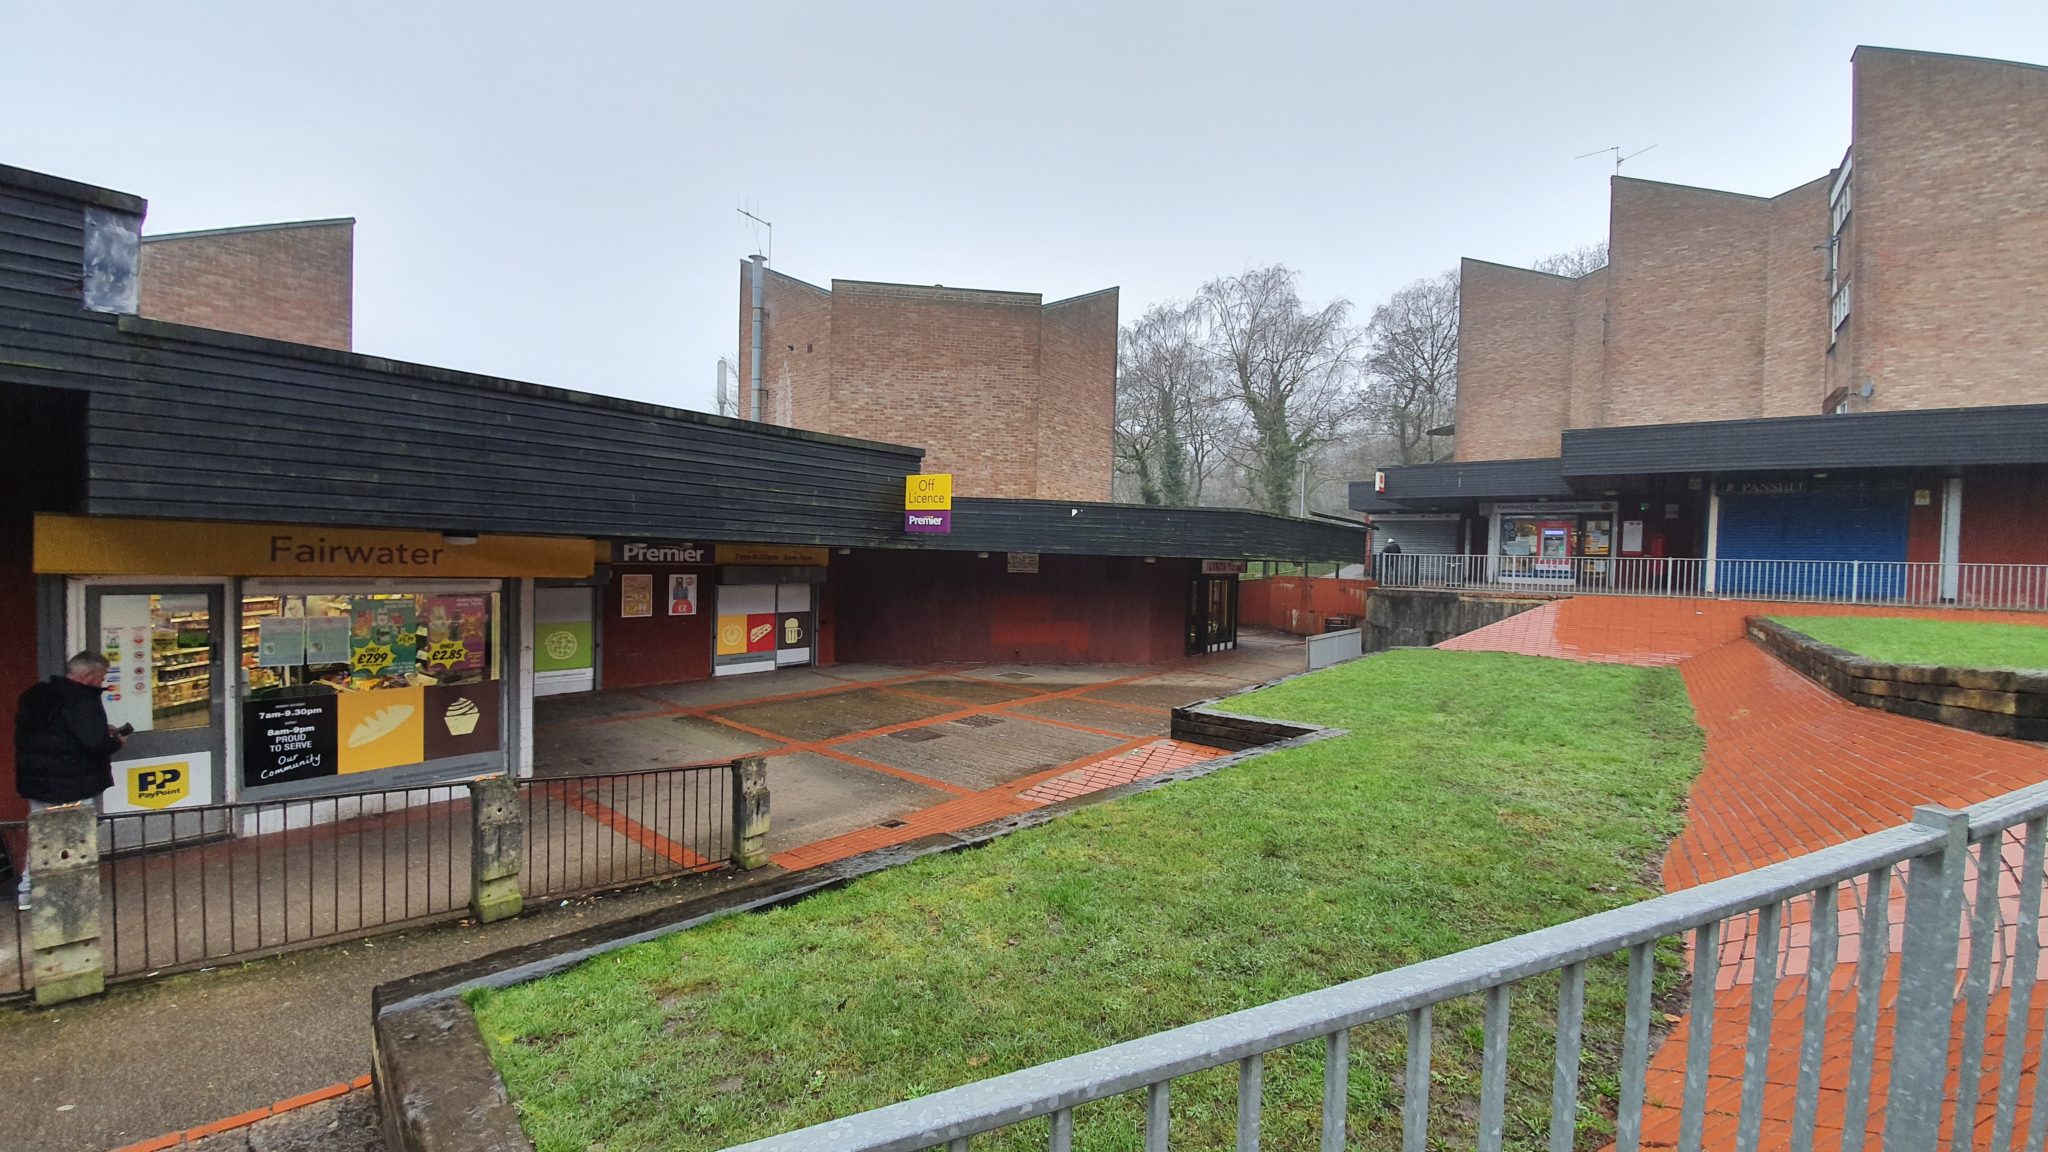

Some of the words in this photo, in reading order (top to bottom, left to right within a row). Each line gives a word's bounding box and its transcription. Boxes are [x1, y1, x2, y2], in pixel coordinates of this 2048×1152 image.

[918, 478, 936, 492] Off
[908, 492, 945, 504] Licence
[908, 514, 943, 526] Premier
[270, 535, 445, 565] Fairwater
[623, 543, 705, 562] Premier
[357, 652, 388, 664] £7.99
[432, 649, 463, 660] £2.85
[258, 707, 323, 720] 7am-9.30pm
[267, 725, 316, 737] 8am-9pm
[275, 733, 307, 744] PROUD
[269, 744, 282, 753] TO
[283, 740, 313, 751] SERVE
[278, 753, 299, 765] Our
[260, 753, 321, 779] Community
[138, 788, 181, 799] PayPoint
